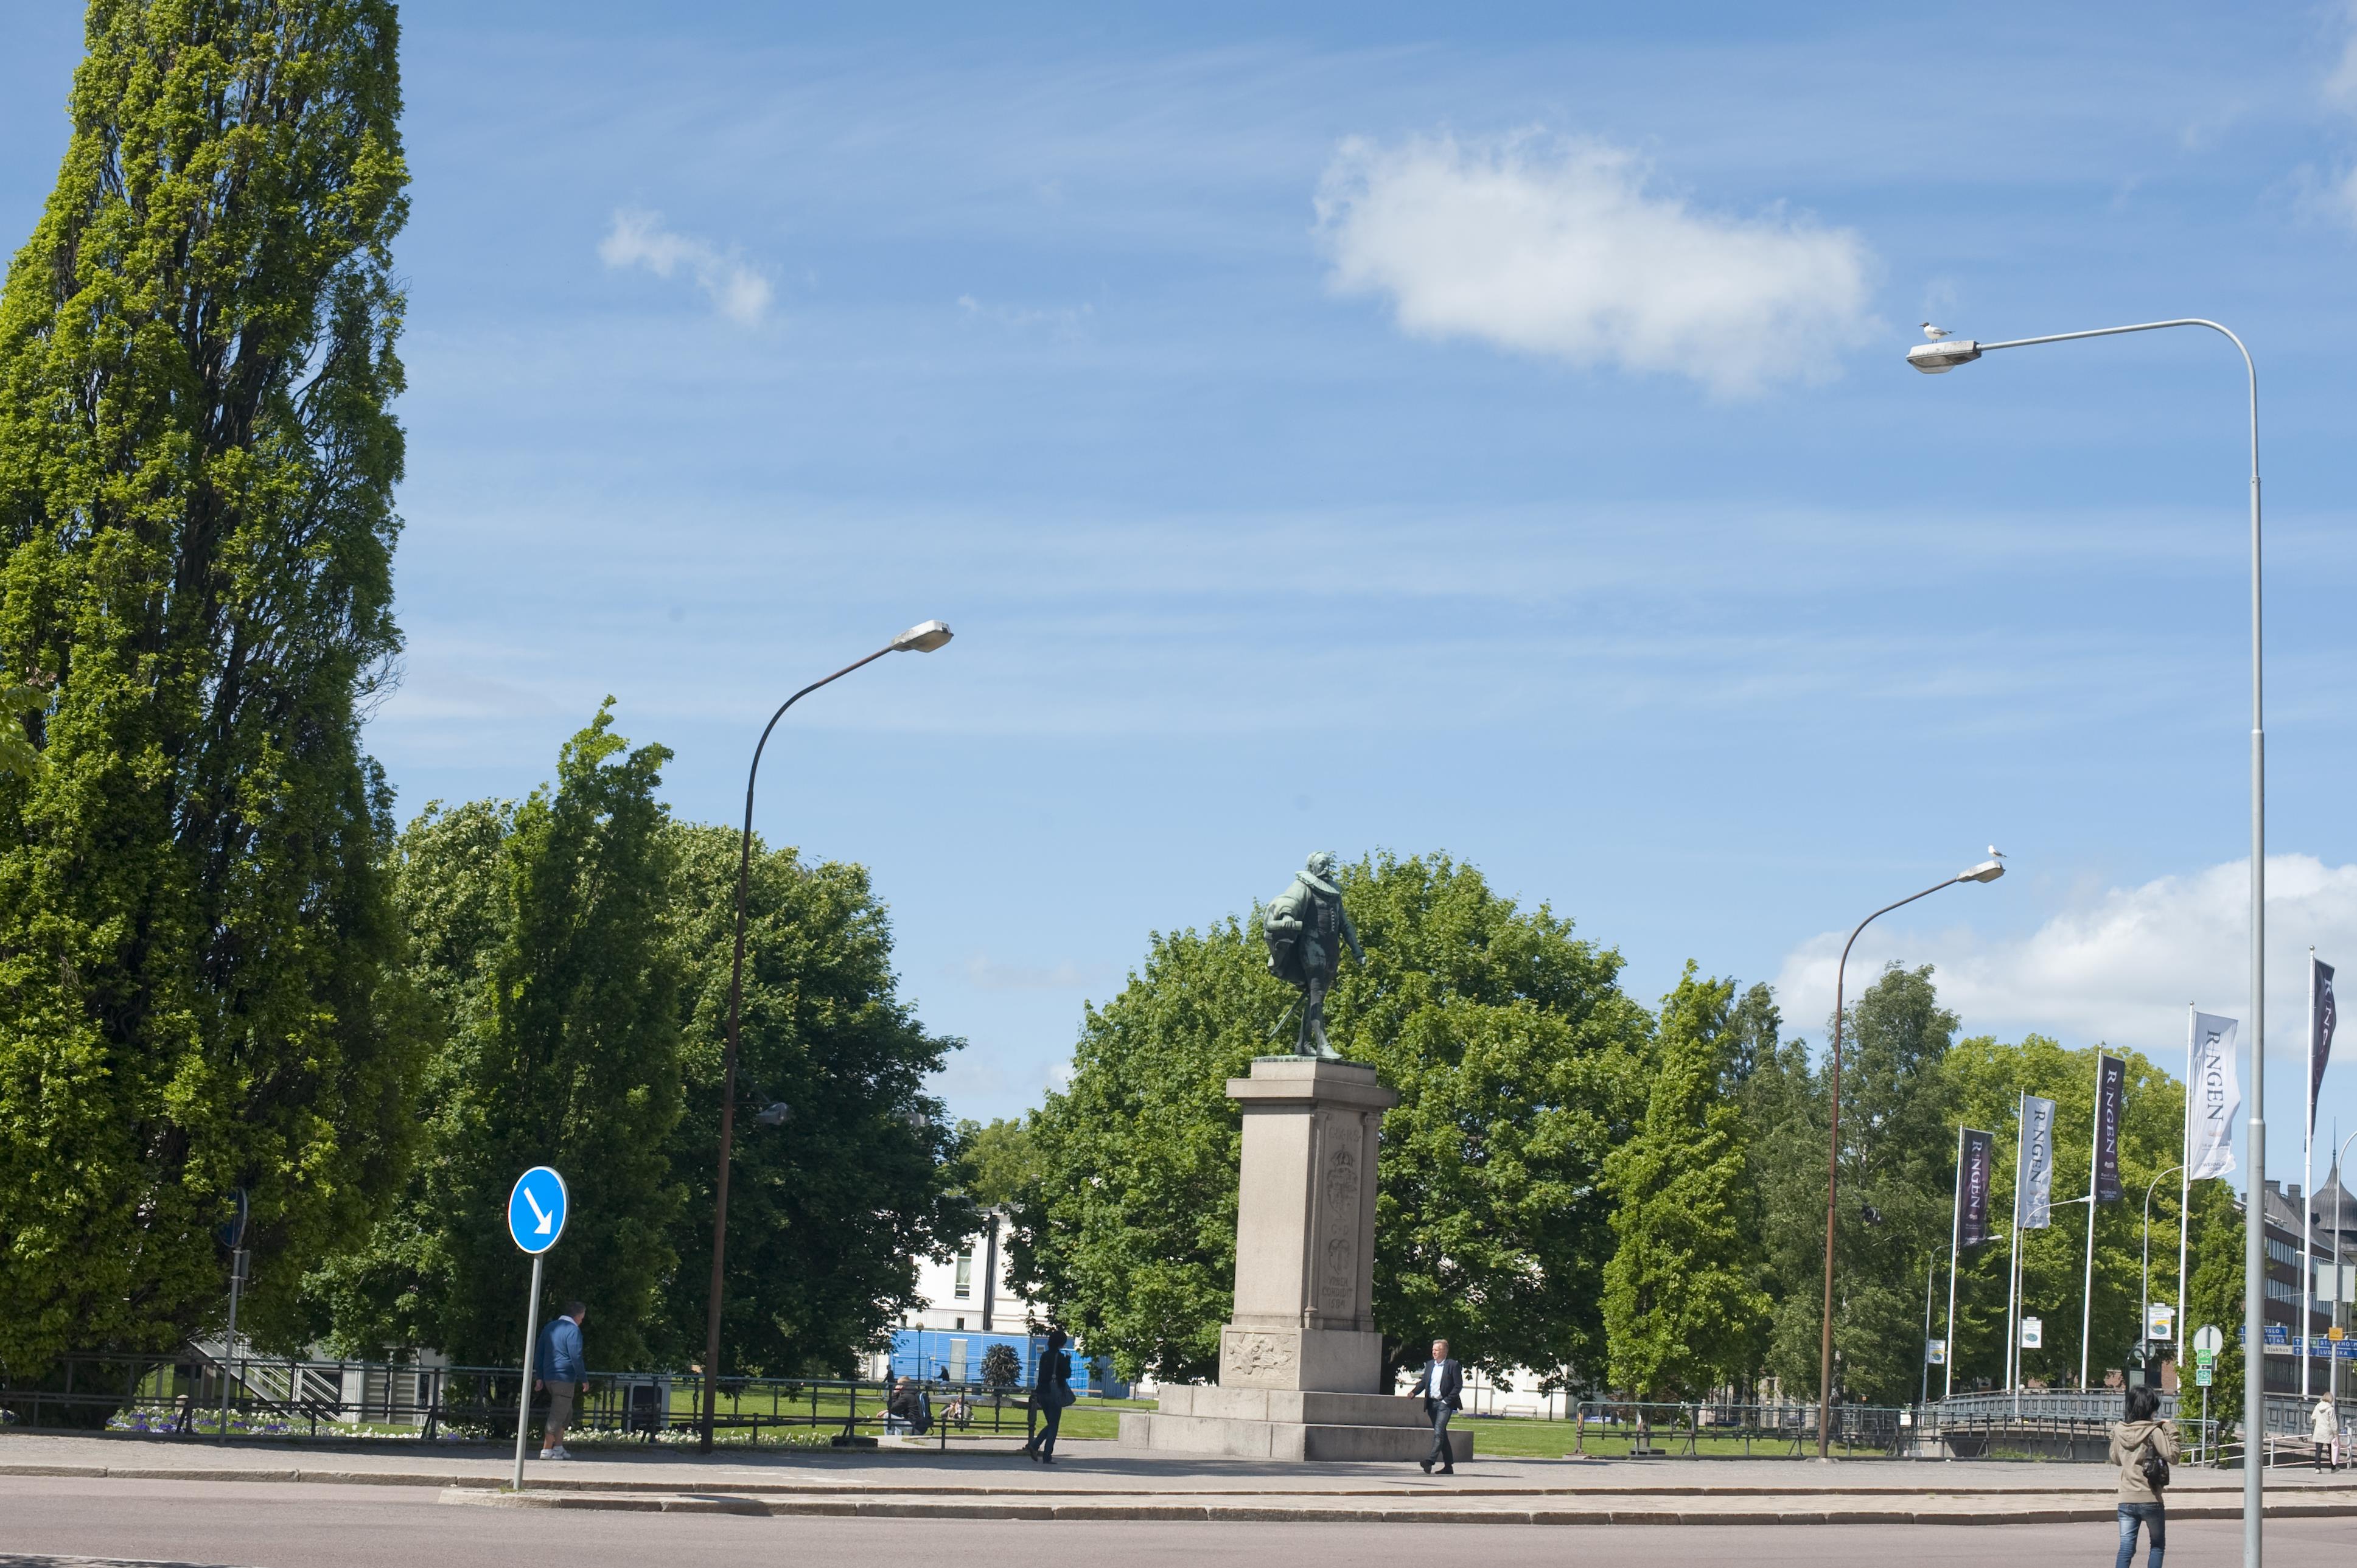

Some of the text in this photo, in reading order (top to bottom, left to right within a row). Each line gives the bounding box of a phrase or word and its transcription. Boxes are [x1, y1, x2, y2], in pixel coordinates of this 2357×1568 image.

[2106, 1069, 2117, 1155] RINGEN
[2206, 1030, 2224, 1121] RINGEN
[1971, 1140, 1983, 1208] RINGEN
[2030, 1109, 2045, 1183] RINGEN
